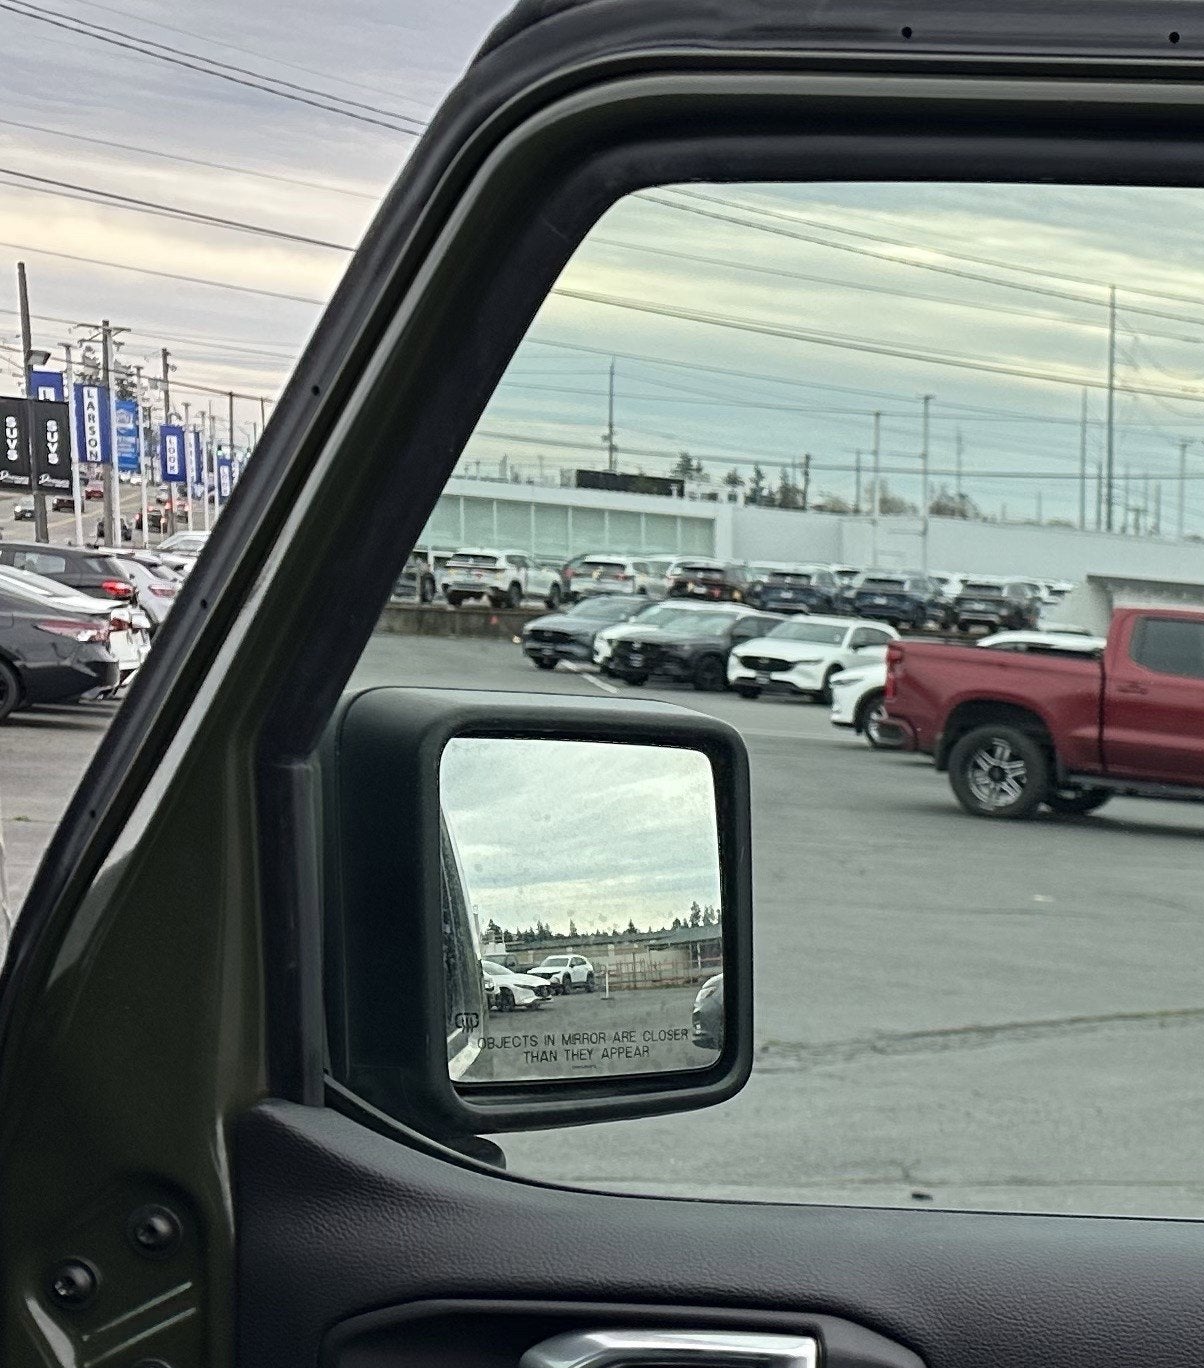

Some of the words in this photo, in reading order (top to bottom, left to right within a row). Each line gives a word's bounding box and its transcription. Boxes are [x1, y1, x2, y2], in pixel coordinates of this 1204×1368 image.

[86, 389, 98, 461] LARSON
[477, 1036, 539, 1050] OBJECTS
[544, 1034, 555, 1046] IN
[561, 1032, 606, 1048] MIRROR
[612, 1030, 636, 1043] ARE
[642, 1028, 689, 1042] CLOSER
[523, 1050, 558, 1064] THAN
[564, 1048, 594, 1061] THEY
[600, 1045, 650, 1059] APPEAR
